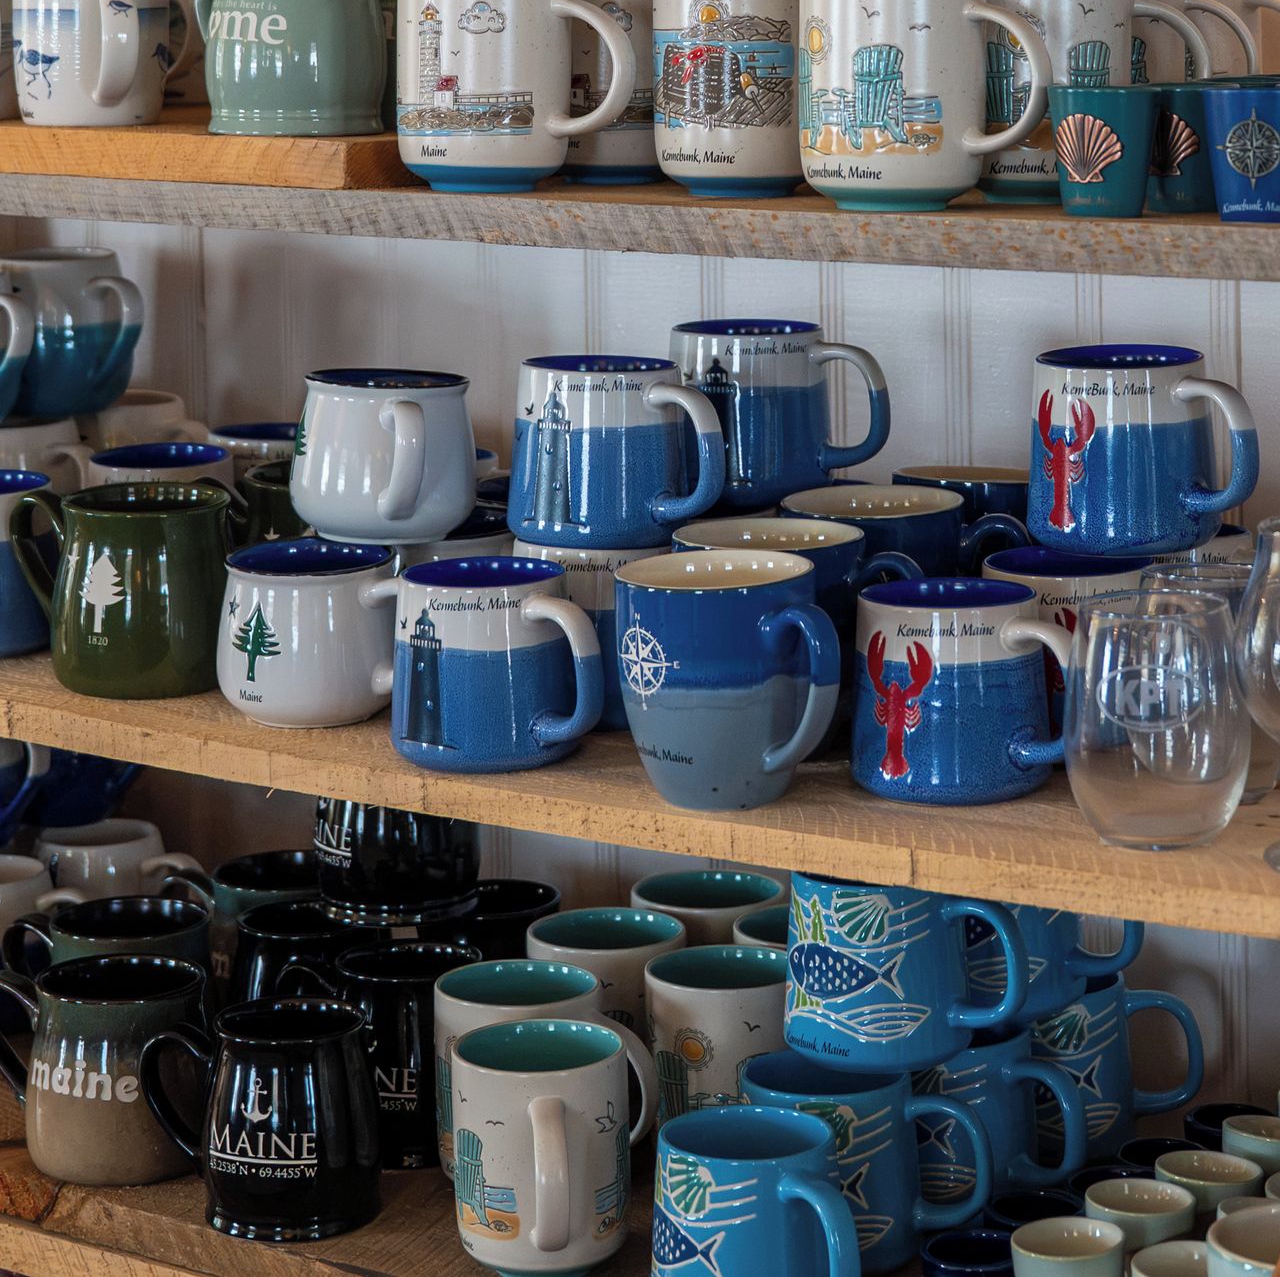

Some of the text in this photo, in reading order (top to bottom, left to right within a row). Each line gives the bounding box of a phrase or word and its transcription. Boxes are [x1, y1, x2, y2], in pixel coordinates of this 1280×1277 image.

[239, 0, 264, 10] heart
[268, 1, 277, 11] is
[420, 144, 447, 158] Maine
[661, 149, 736, 165] Kennebunk, Maine
[806, 162, 882, 180] Kennebunk, Maine
[990, 158, 1050, 174] Kennebunk,
[781, 342, 808, 354] Maine
[611, 379, 643, 392] Maine
[1123, 382, 1156, 395] Maine
[428, 596, 521, 612] Kennebunk, Maine
[961, 623, 995, 637] Maine
[87, 635, 109, 646] 1820
[239, 689, 263, 703] Maine
[1115, 679, 1183, 718] KPT
[662, 748, 694, 765] Maine
[821, 1041, 850, 1057] Maine
[31, 1057, 139, 1103] maine
[209, 1119, 317, 1159] MAINE
